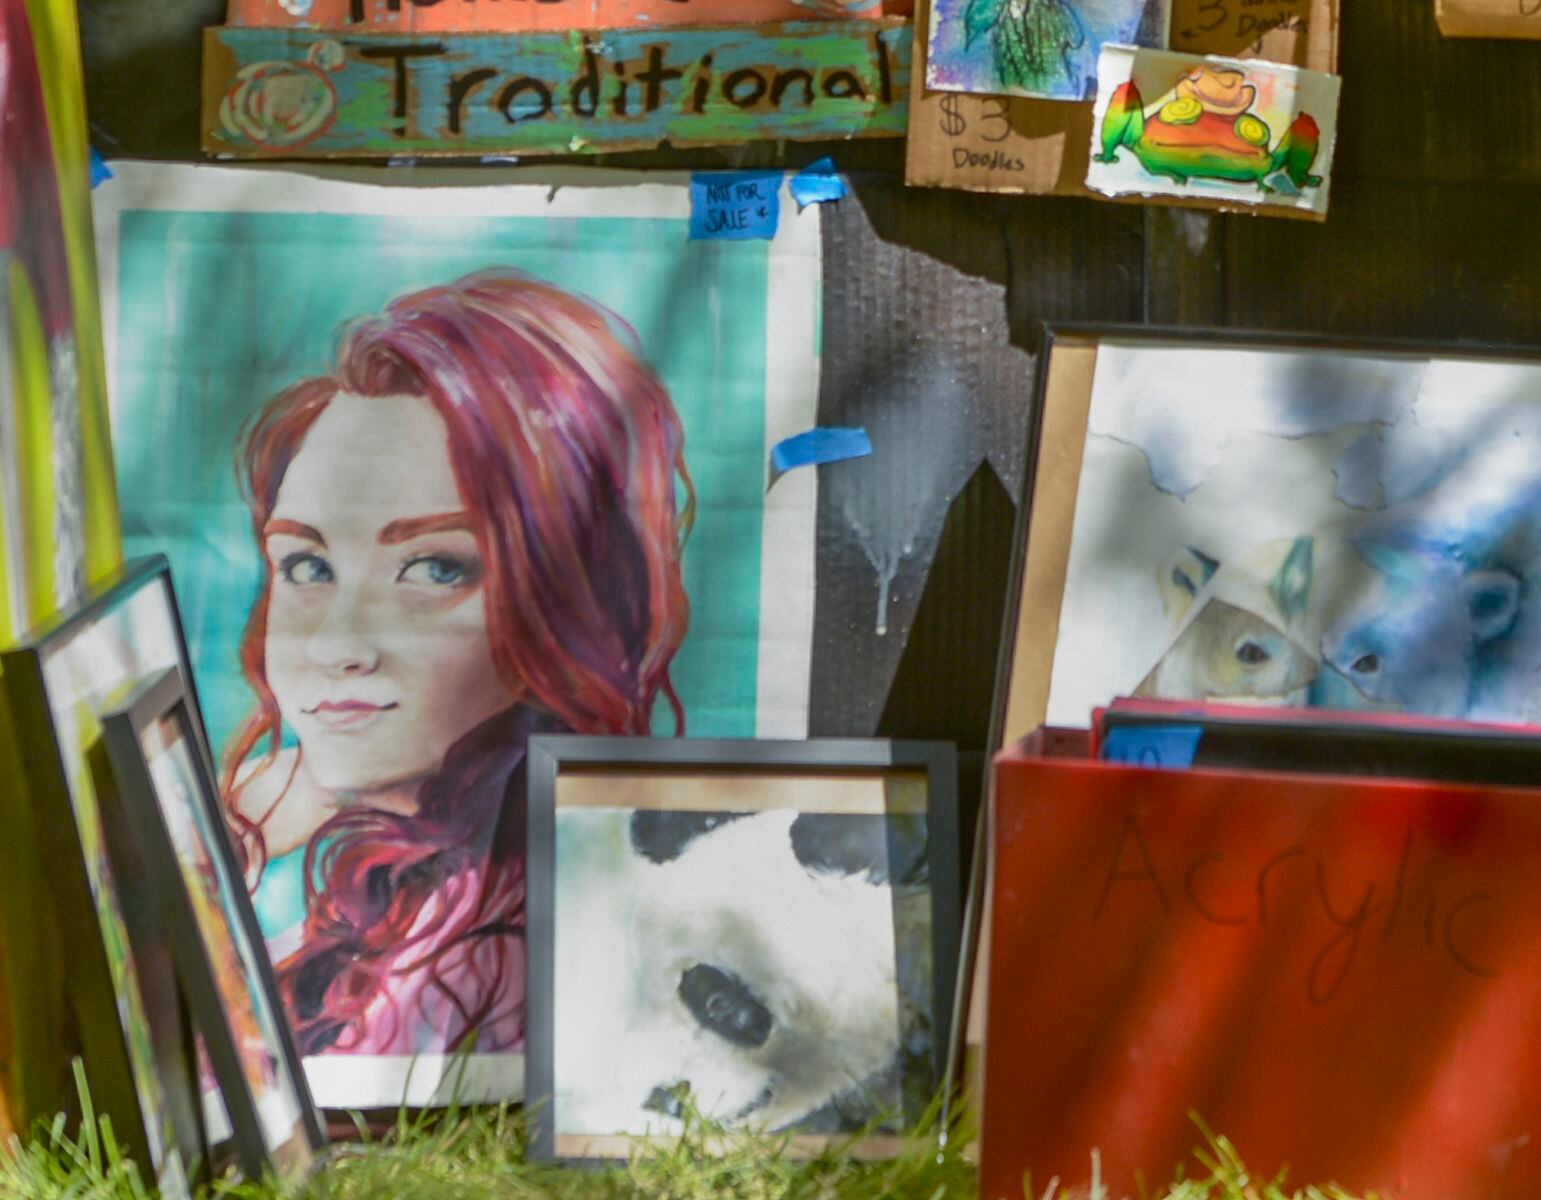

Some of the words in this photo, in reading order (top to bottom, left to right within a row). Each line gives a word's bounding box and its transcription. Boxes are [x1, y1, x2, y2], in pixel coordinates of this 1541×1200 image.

[359, 30, 892, 136] Traditional
[952, 147, 1026, 174] Doodles
[704, 206, 749, 233] SALE
[1093, 813, 1498, 1007] Acrylic
